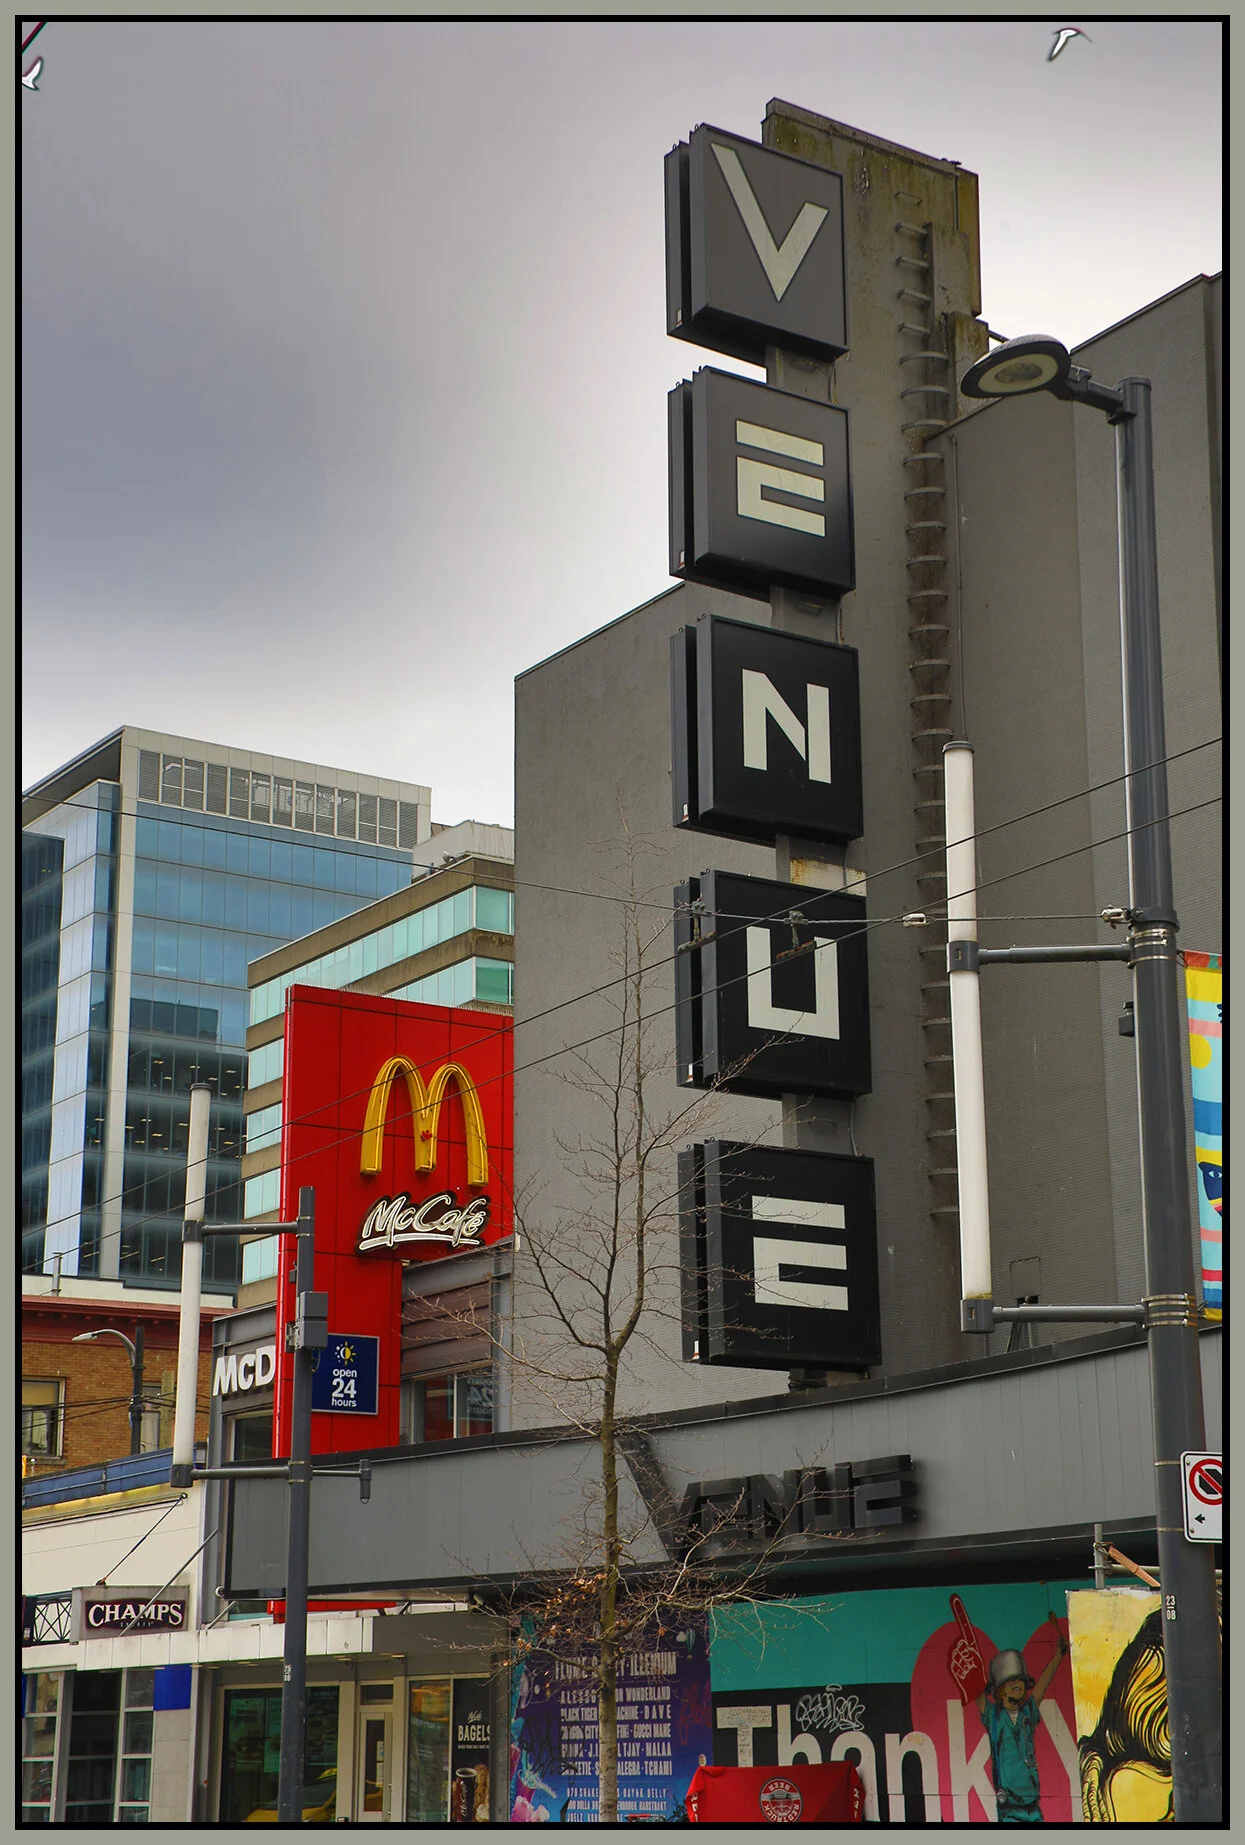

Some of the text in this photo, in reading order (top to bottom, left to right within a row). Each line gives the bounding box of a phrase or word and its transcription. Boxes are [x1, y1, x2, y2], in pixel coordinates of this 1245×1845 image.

[711, 142, 850, 1313] VENUE
[358, 1194, 488, 1250] McCafé
[332, 1368, 357, 1378] open
[332, 1378, 357, 1398] 24
[331, 1397, 357, 1408] hours
[614, 1438, 915, 1562] VENUE
[1165, 1595, 1176, 1606] 23
[88, 1603, 183, 1627] CHAMPS
[1166, 1609, 1177, 1620] 08
[581, 1707, 598, 1721] TIGER
[616, 1705, 639, 1720] ACHINE
[644, 1704, 672, 1719] DAVE
[653, 1723, 672, 1738] MANE
[622, 1743, 641, 1757] TJAY
[645, 1742, 672, 1757] MALAA
[644, 1761, 673, 1775] TCHAMI
[768, 1781, 791, 1792] BEER
